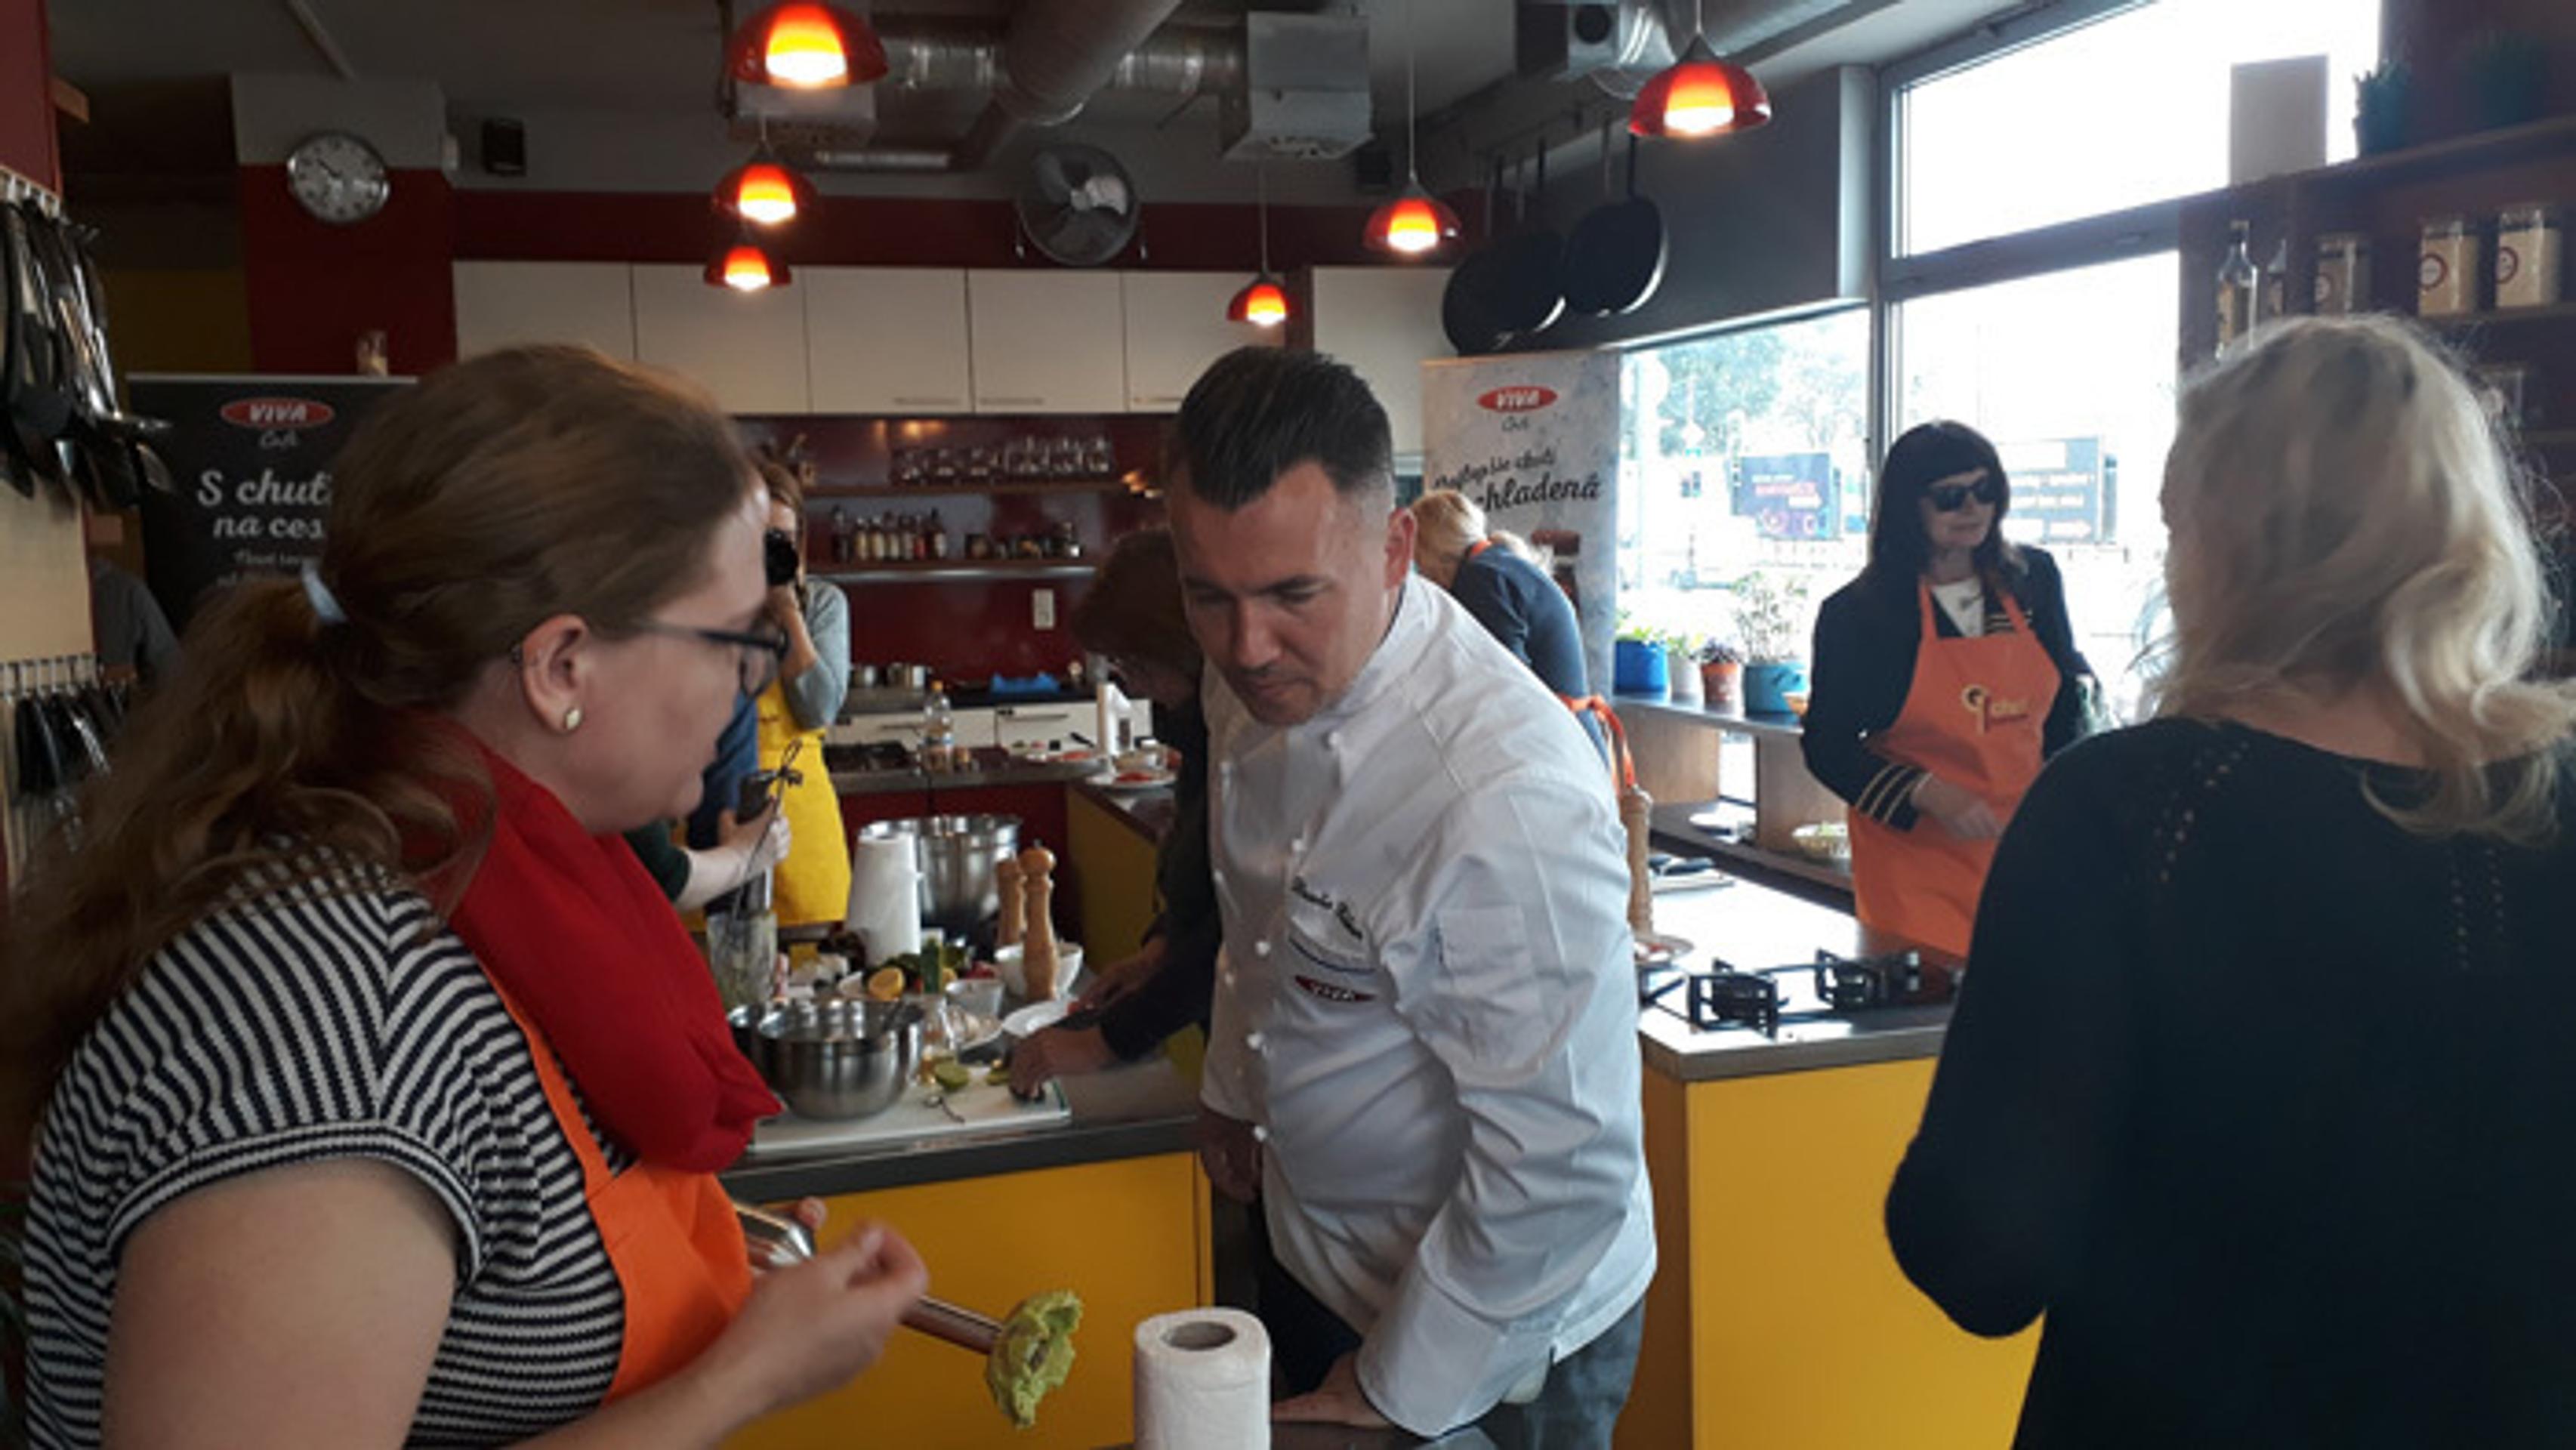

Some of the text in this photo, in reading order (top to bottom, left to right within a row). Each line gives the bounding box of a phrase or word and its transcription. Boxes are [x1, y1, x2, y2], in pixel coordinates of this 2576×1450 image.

[1497, 390, 1540, 409] VIVA
[248, 404, 307, 421] VIVA
[196, 468, 224, 508] S
[1475, 471, 1602, 512] hladená
[213, 516, 325, 540] na ces
